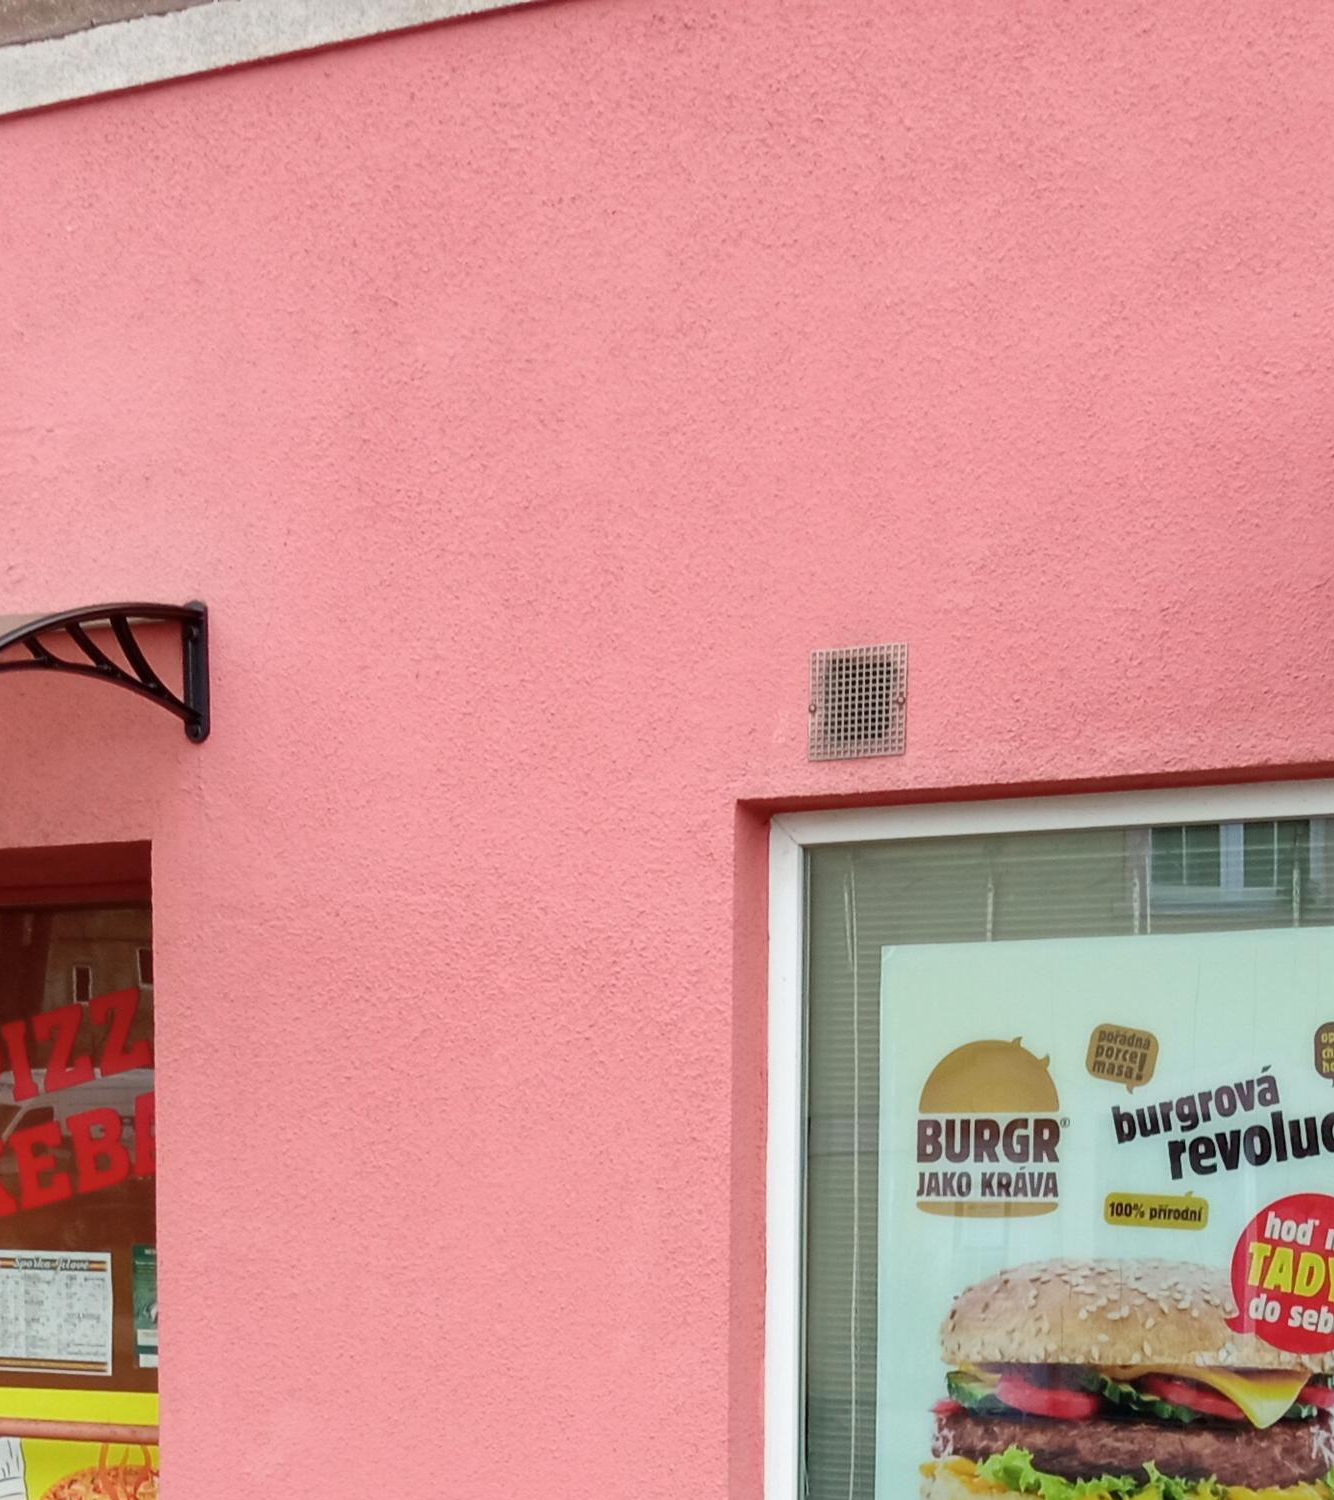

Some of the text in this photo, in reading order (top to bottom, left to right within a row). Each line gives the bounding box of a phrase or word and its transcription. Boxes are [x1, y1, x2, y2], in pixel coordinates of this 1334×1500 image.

[1095, 1044, 1139, 1065] porce
[1112, 1065, 1280, 1144] burgrová
[916, 1166, 1059, 1197] JAKO KRÁVA
[1109, 1202, 1203, 1223] 100% přírodní
[1264, 1211, 1319, 1246] hoď
[1248, 1293, 1280, 1322] do
